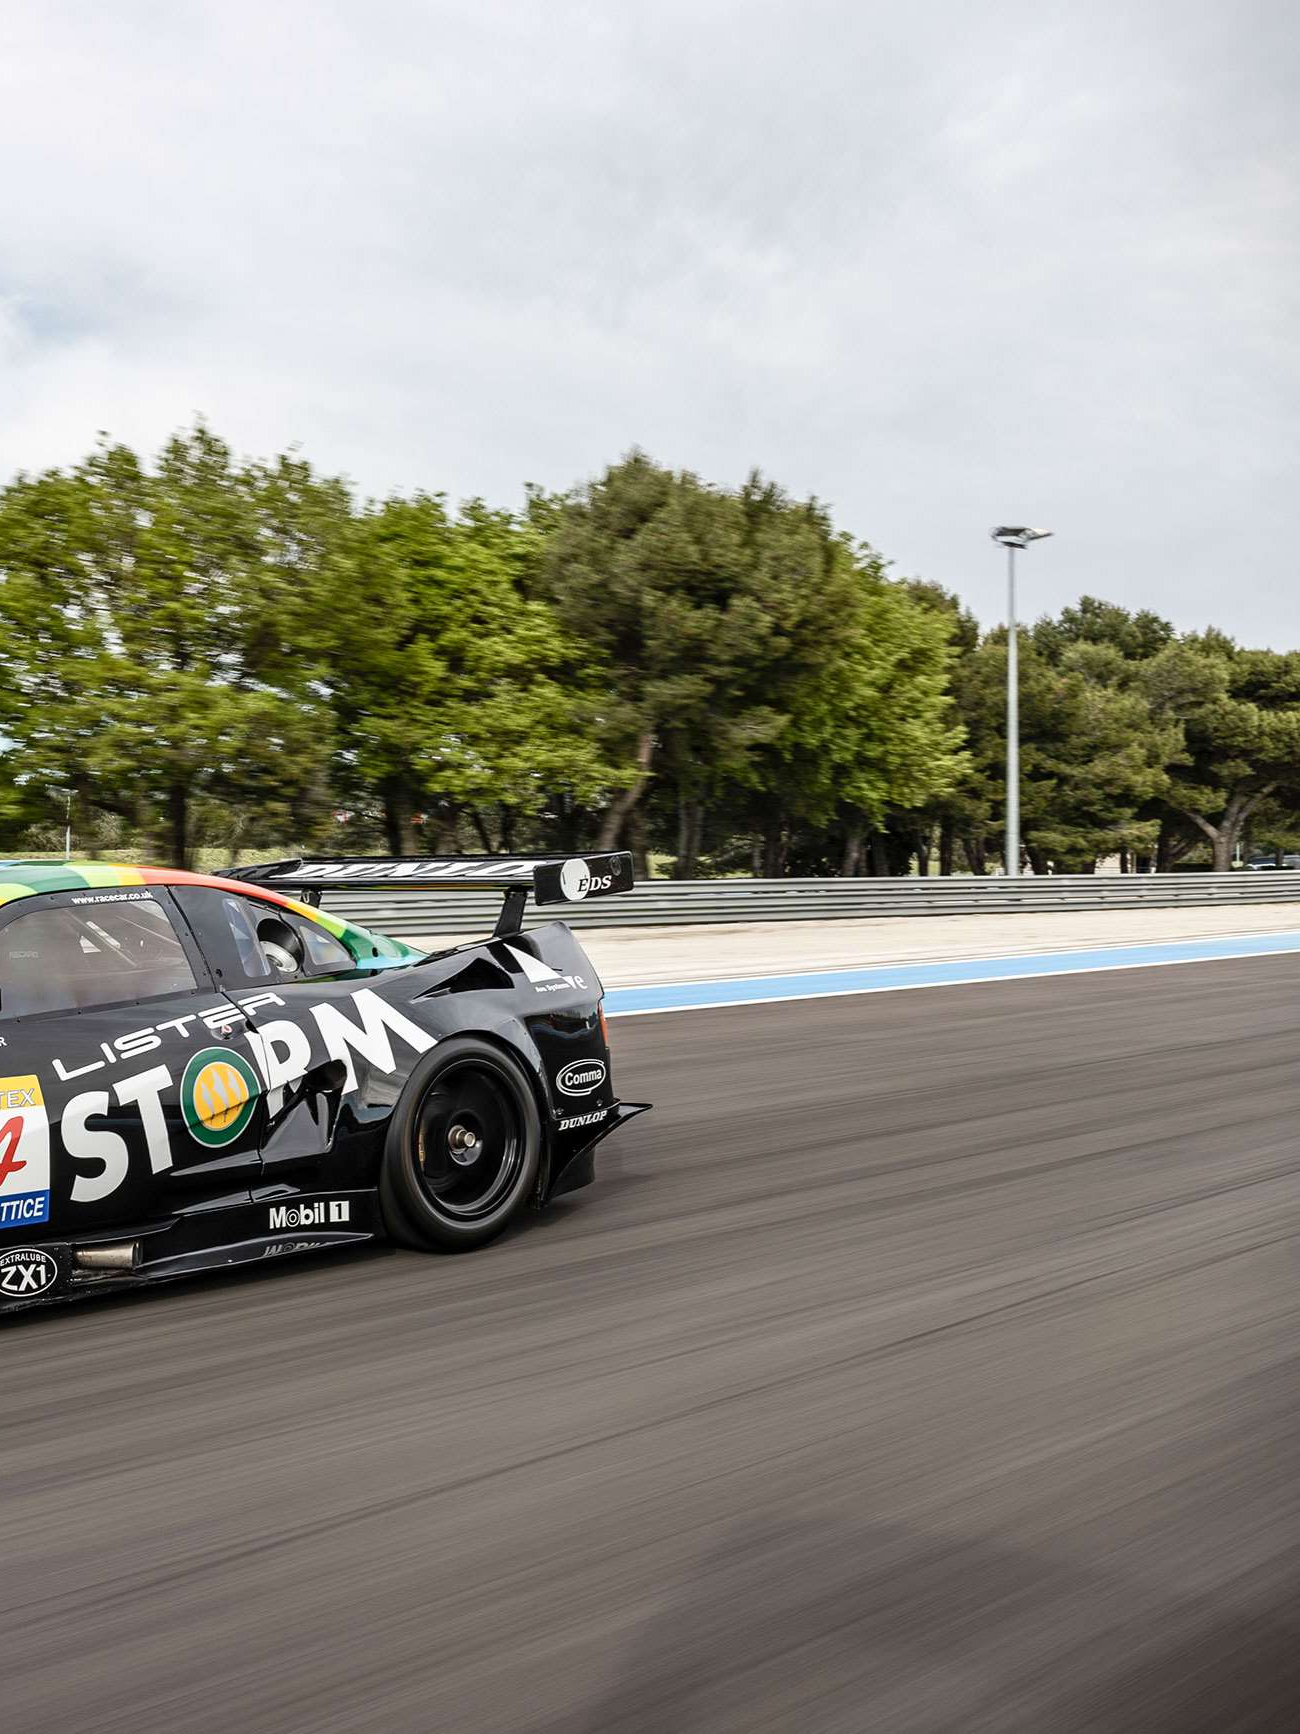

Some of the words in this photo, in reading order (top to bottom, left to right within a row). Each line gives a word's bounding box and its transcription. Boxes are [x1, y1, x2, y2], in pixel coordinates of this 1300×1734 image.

[270, 861, 540, 878] DUNLO
[577, 875, 612, 893] EDS
[71, 890, 154, 905] www.racecar.co.uk
[52, 992, 287, 1082] LISTER
[564, 1067, 603, 1087] Comma
[558, 1109, 609, 1132] DUNLOP
[268, 1201, 326, 1230] Mobil
[329, 1200, 351, 1222] 1
[0, 1252, 47, 1267] EXTRALUBE
[0, 1263, 47, 1292] ZX1
